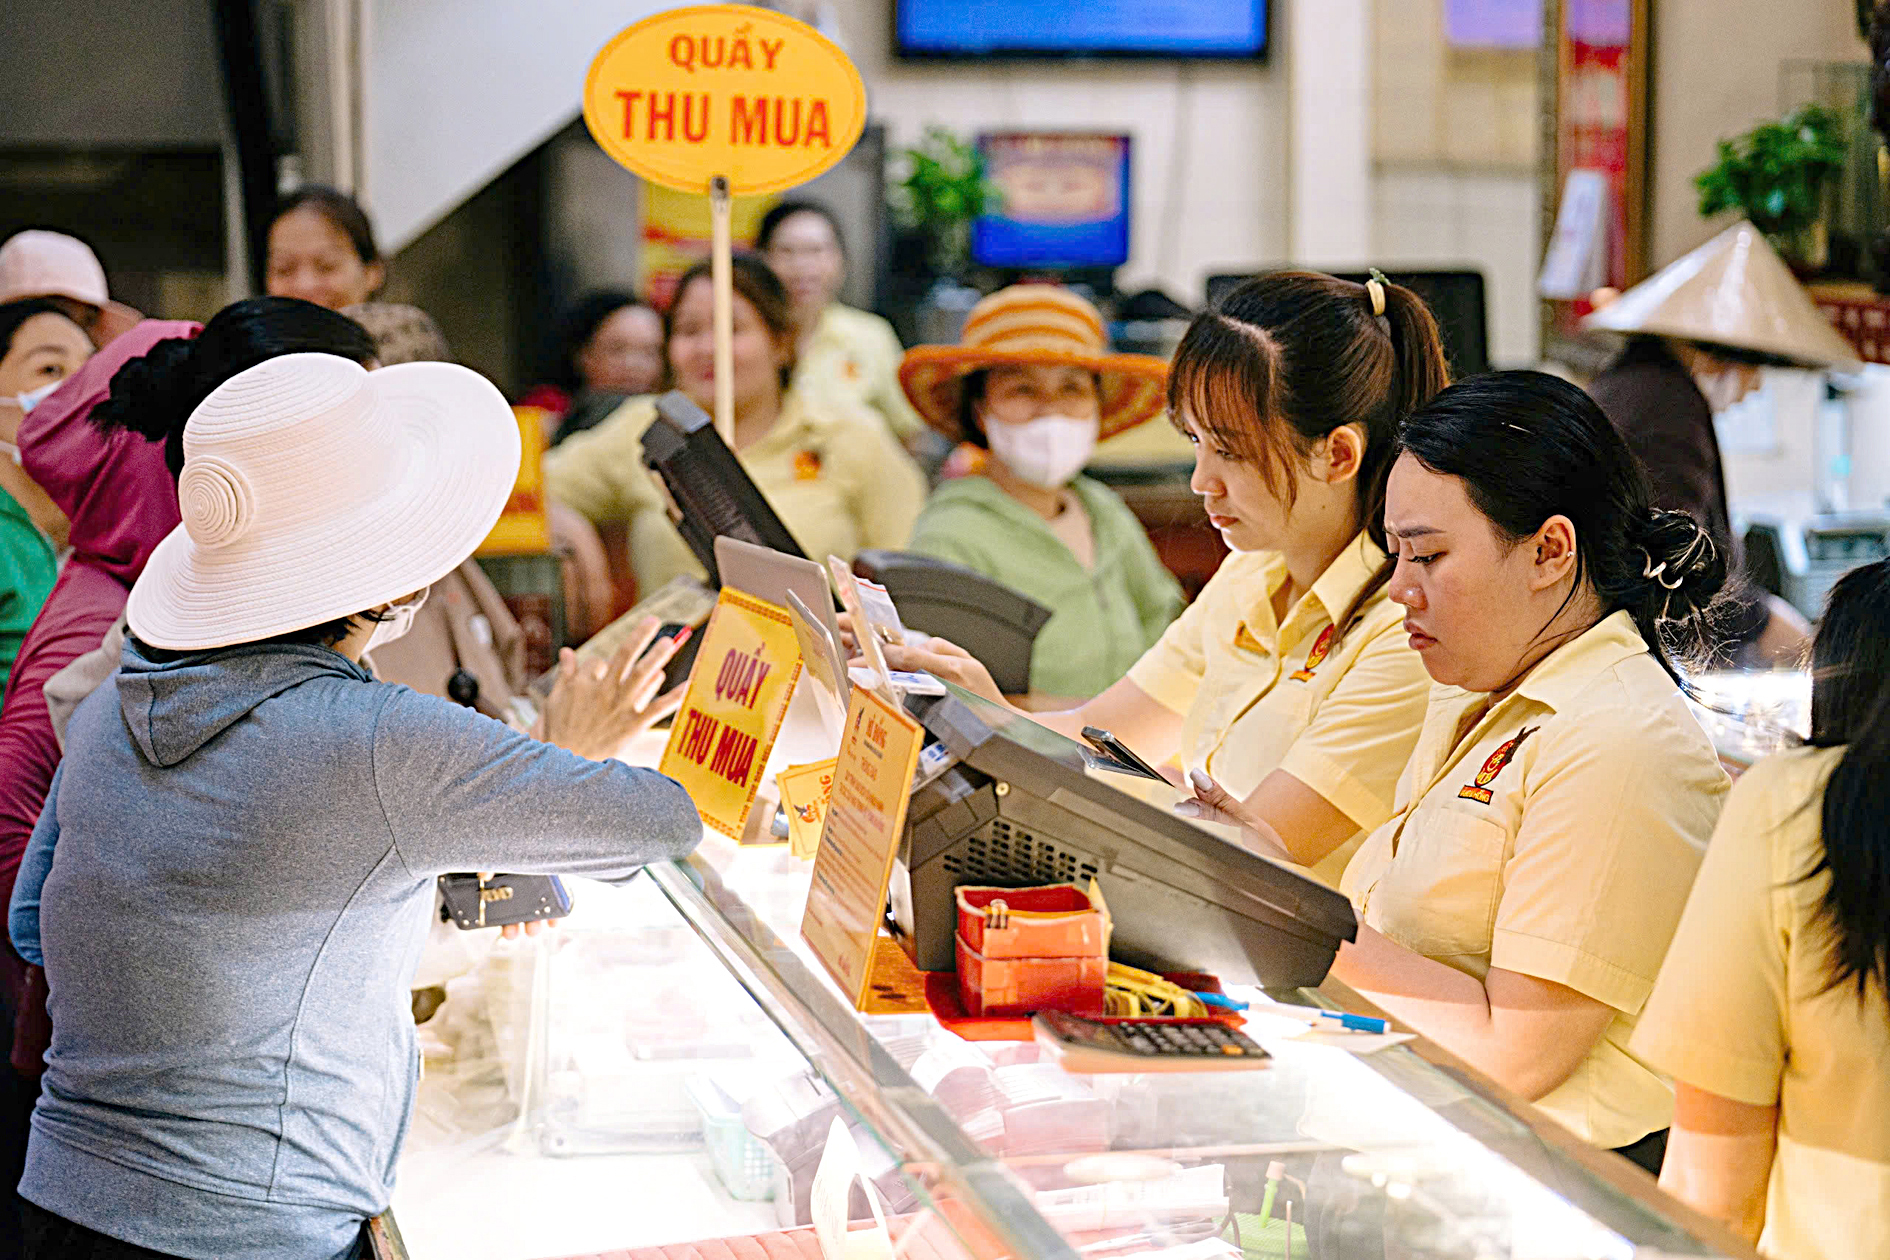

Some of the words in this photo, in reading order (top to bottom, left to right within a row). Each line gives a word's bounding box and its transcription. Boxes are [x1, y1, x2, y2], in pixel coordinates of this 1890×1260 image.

[614, 91, 708, 142] THU
[729, 95, 831, 148] MUA
[677, 708, 719, 765] THU
[710, 724, 758, 788] MUA
